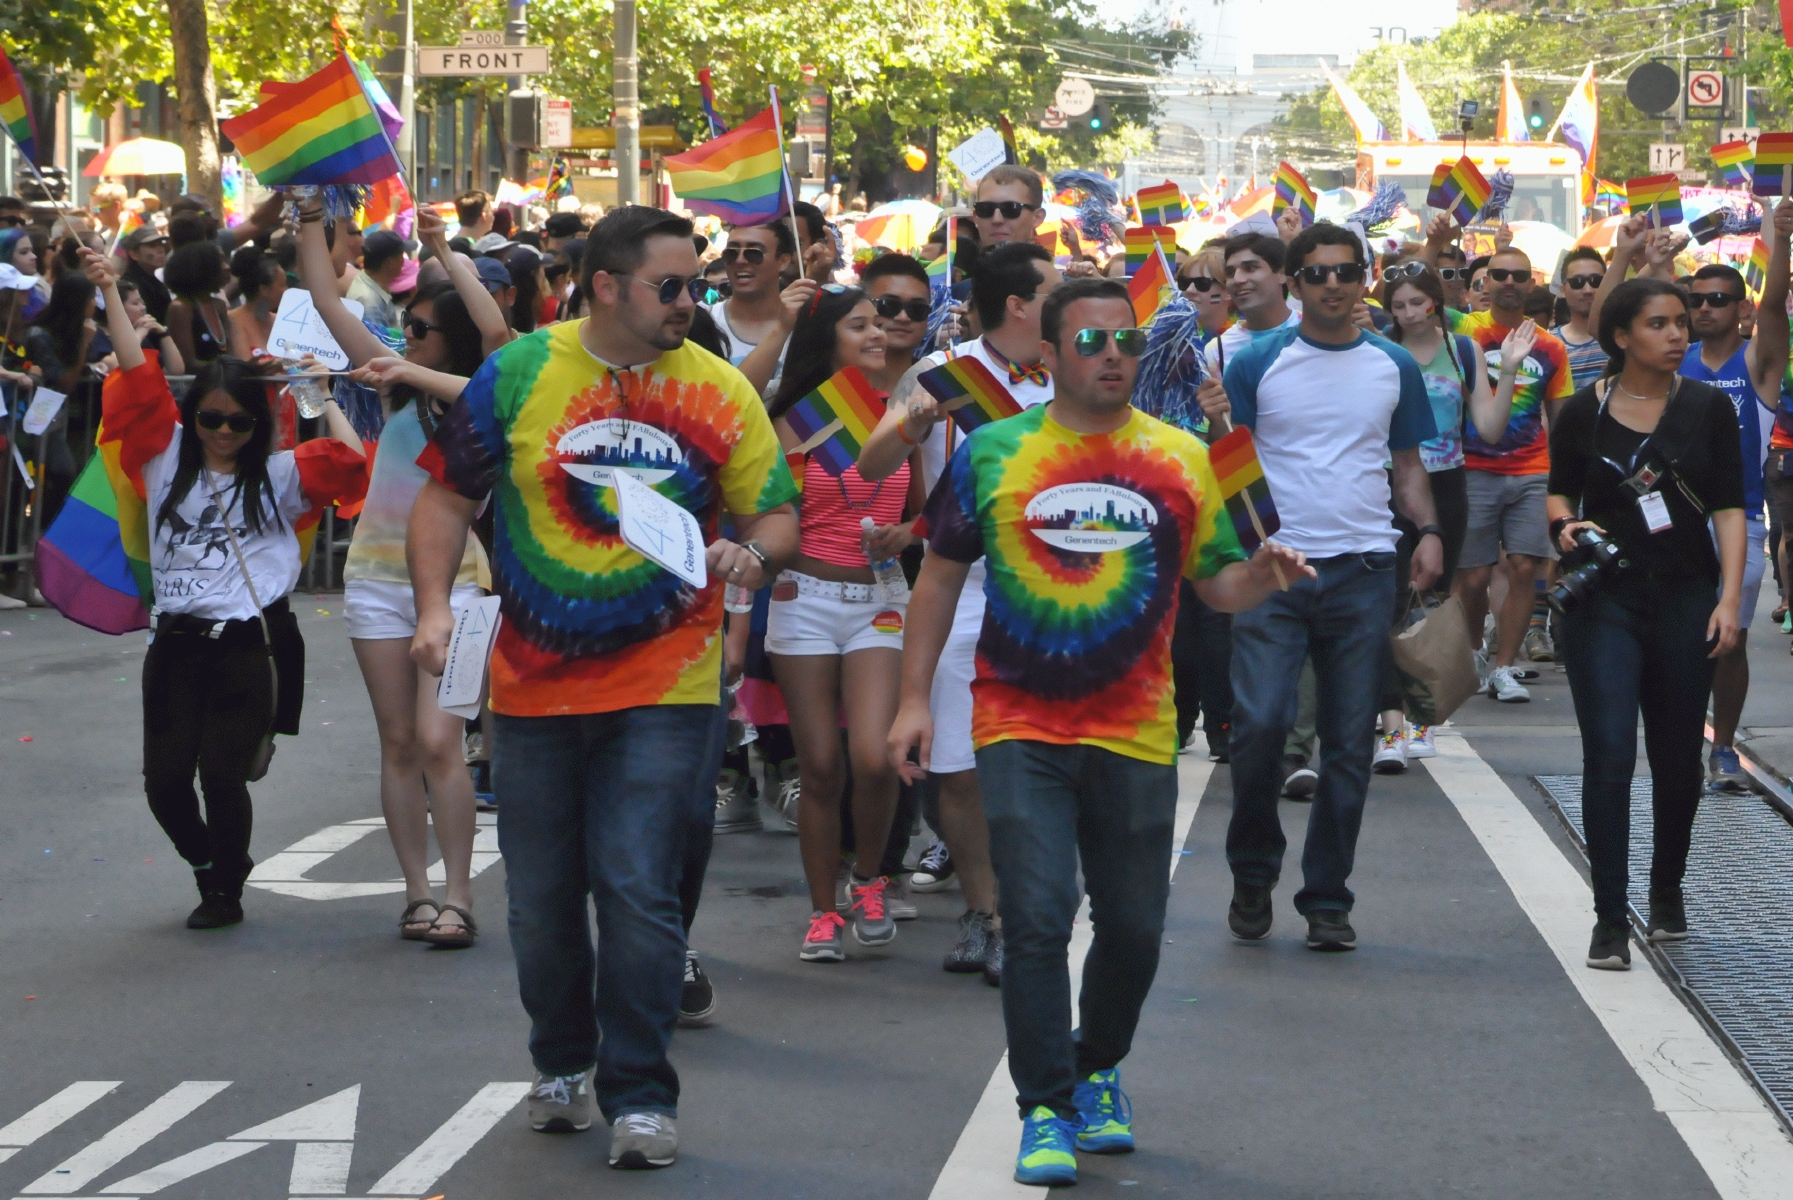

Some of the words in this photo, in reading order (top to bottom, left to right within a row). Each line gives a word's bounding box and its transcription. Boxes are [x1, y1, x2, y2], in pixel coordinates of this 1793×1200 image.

[476, 34, 501, 44] 000
[442, 53, 523, 69] FRONT
[276, 338, 341, 360] Gnentech
[568, 428, 589, 442] Forty
[590, 422, 614, 431] Years
[1036, 491, 1058, 506] Forty
[1059, 486, 1084, 495] Years
[677, 512, 695, 573] Genentech
[1064, 536, 1117, 545] Genentech
[446, 609, 469, 695] Genentech
